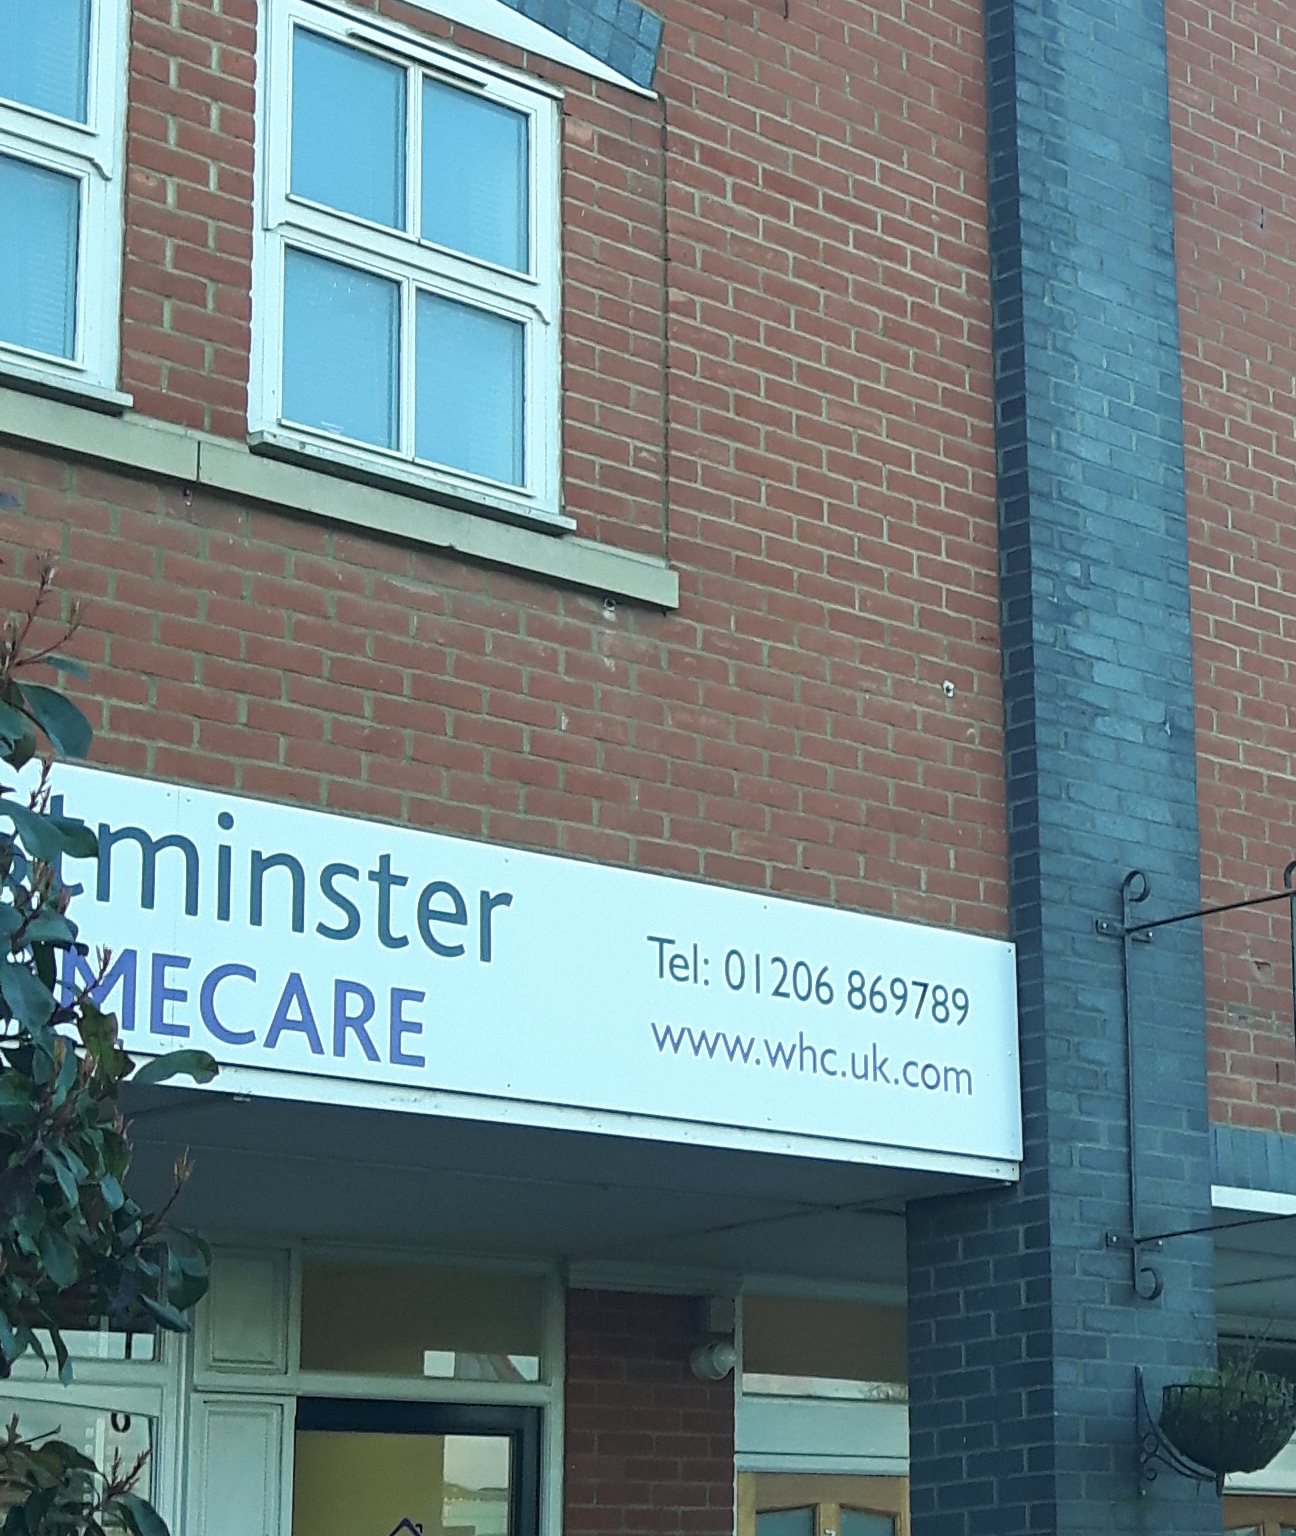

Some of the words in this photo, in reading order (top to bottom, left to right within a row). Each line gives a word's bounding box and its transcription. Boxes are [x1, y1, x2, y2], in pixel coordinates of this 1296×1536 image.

[647, 935, 710, 987] Tel:
[724, 948, 835, 1005] 01206
[847, 970, 970, 1026] 869789
[651, 1022, 973, 1096] www.whc.uk.com
